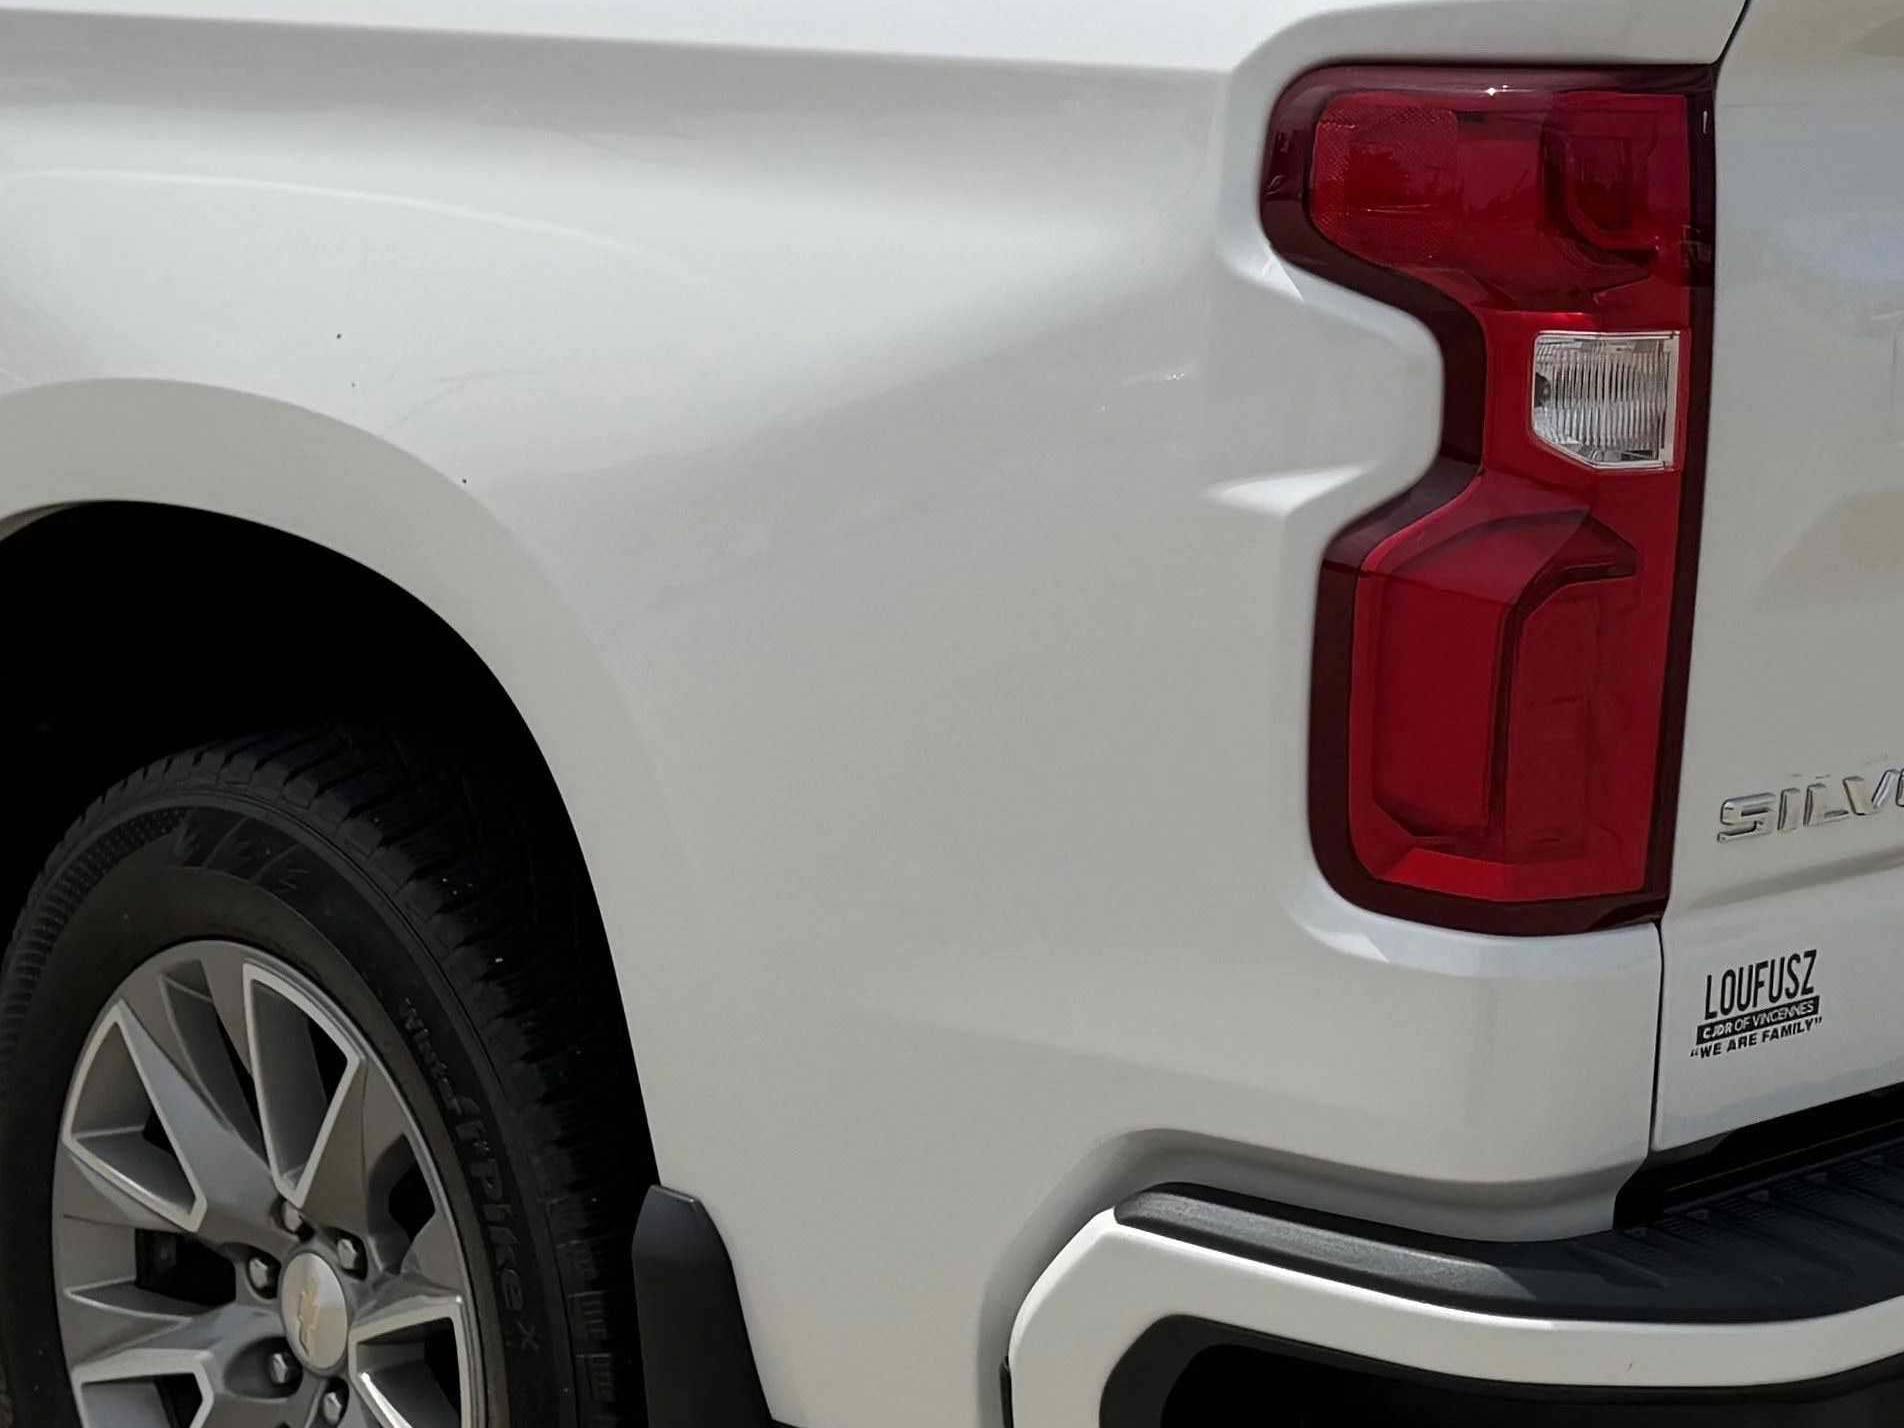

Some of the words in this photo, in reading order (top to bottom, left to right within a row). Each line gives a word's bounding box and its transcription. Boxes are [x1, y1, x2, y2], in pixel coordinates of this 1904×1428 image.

[1702, 1021, 1733, 1040] CJDR
[1734, 1014, 1752, 1032] OF
[1752, 1001, 1815, 1028] VINCENNES
[1726, 1032, 1758, 1053] ARE
